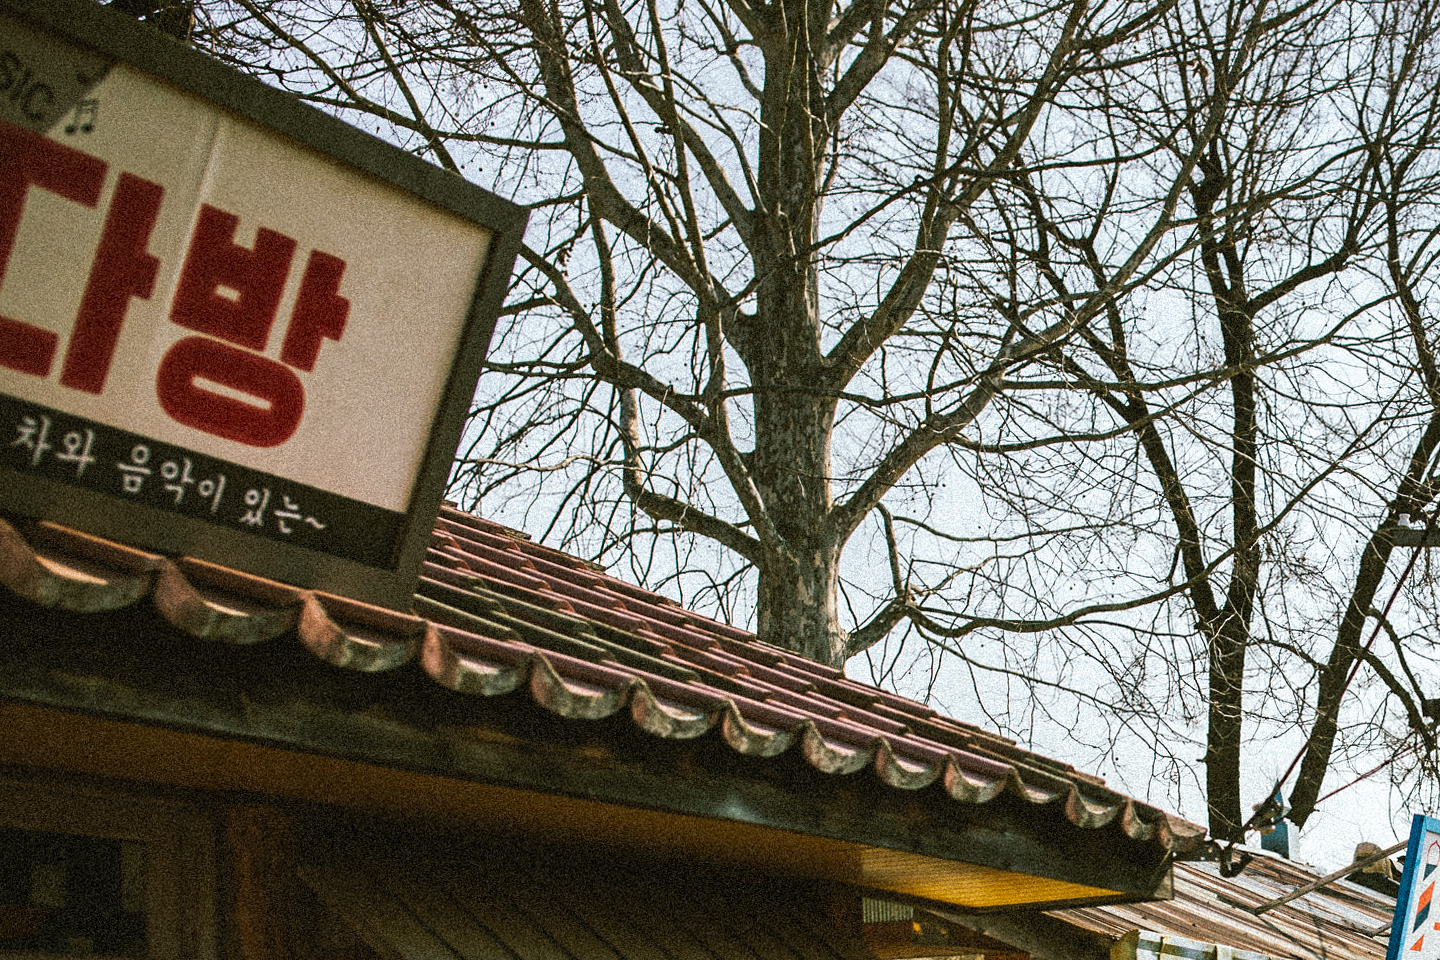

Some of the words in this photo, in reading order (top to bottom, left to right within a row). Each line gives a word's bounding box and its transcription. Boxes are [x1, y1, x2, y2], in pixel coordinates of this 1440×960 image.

[0, 120, 351, 449] 다방
[11, 415, 96, 471] 차와
[117, 445, 226, 512] 음악이
